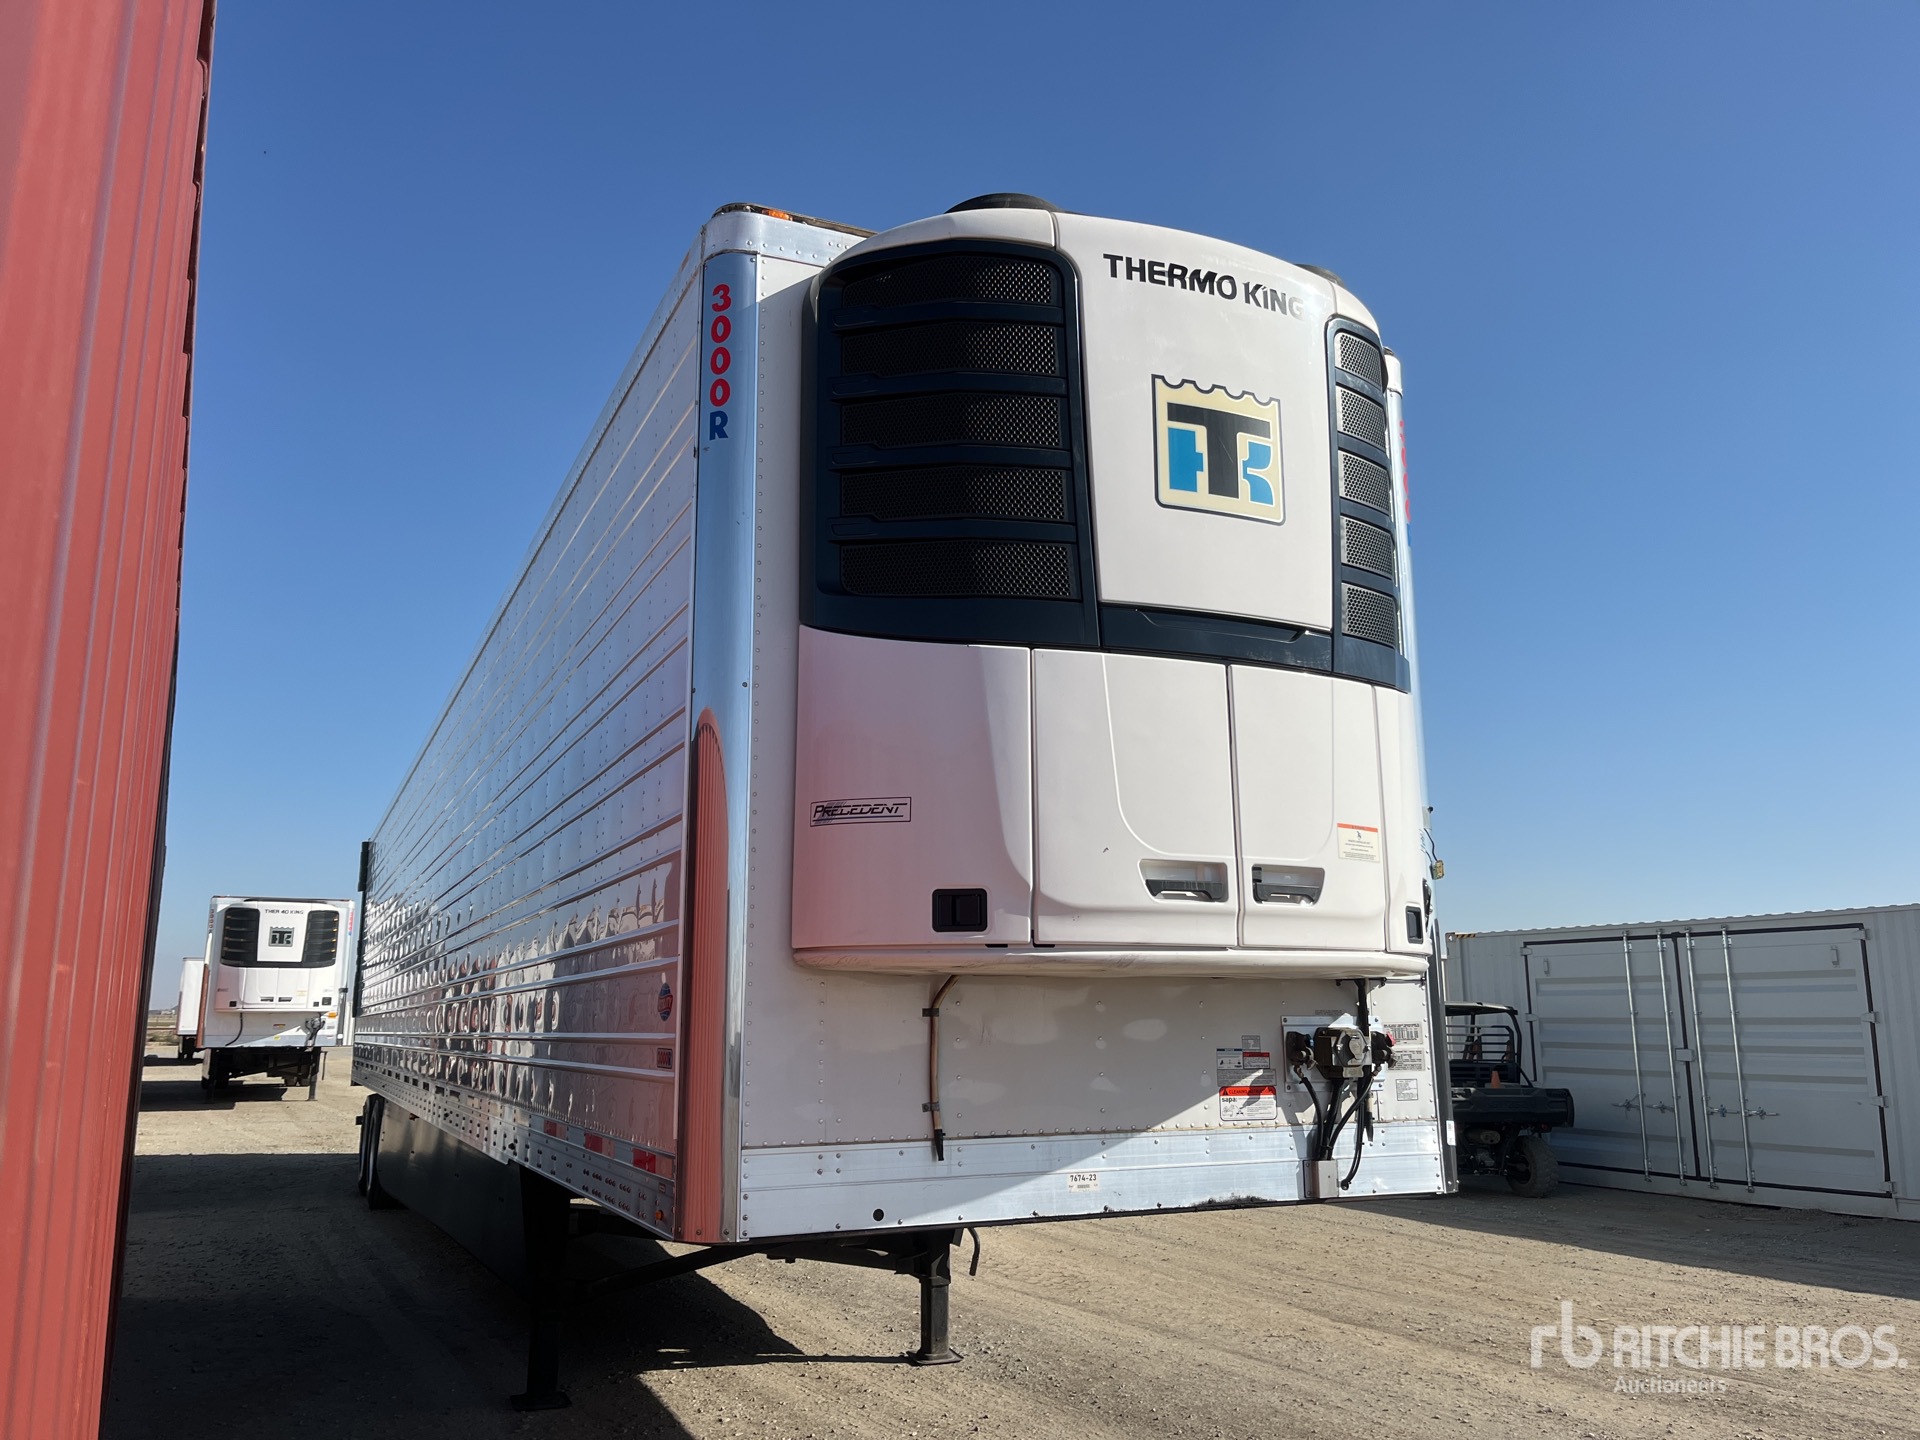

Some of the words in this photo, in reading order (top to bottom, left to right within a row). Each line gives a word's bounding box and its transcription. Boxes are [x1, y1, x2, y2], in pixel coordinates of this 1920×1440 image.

[1102, 253, 1238, 301] THERMO
[709, 283, 732, 441] 3000R
[813, 802, 908, 818] PRECEDENT
[1070, 1174, 1096, 1182] 7674-23
